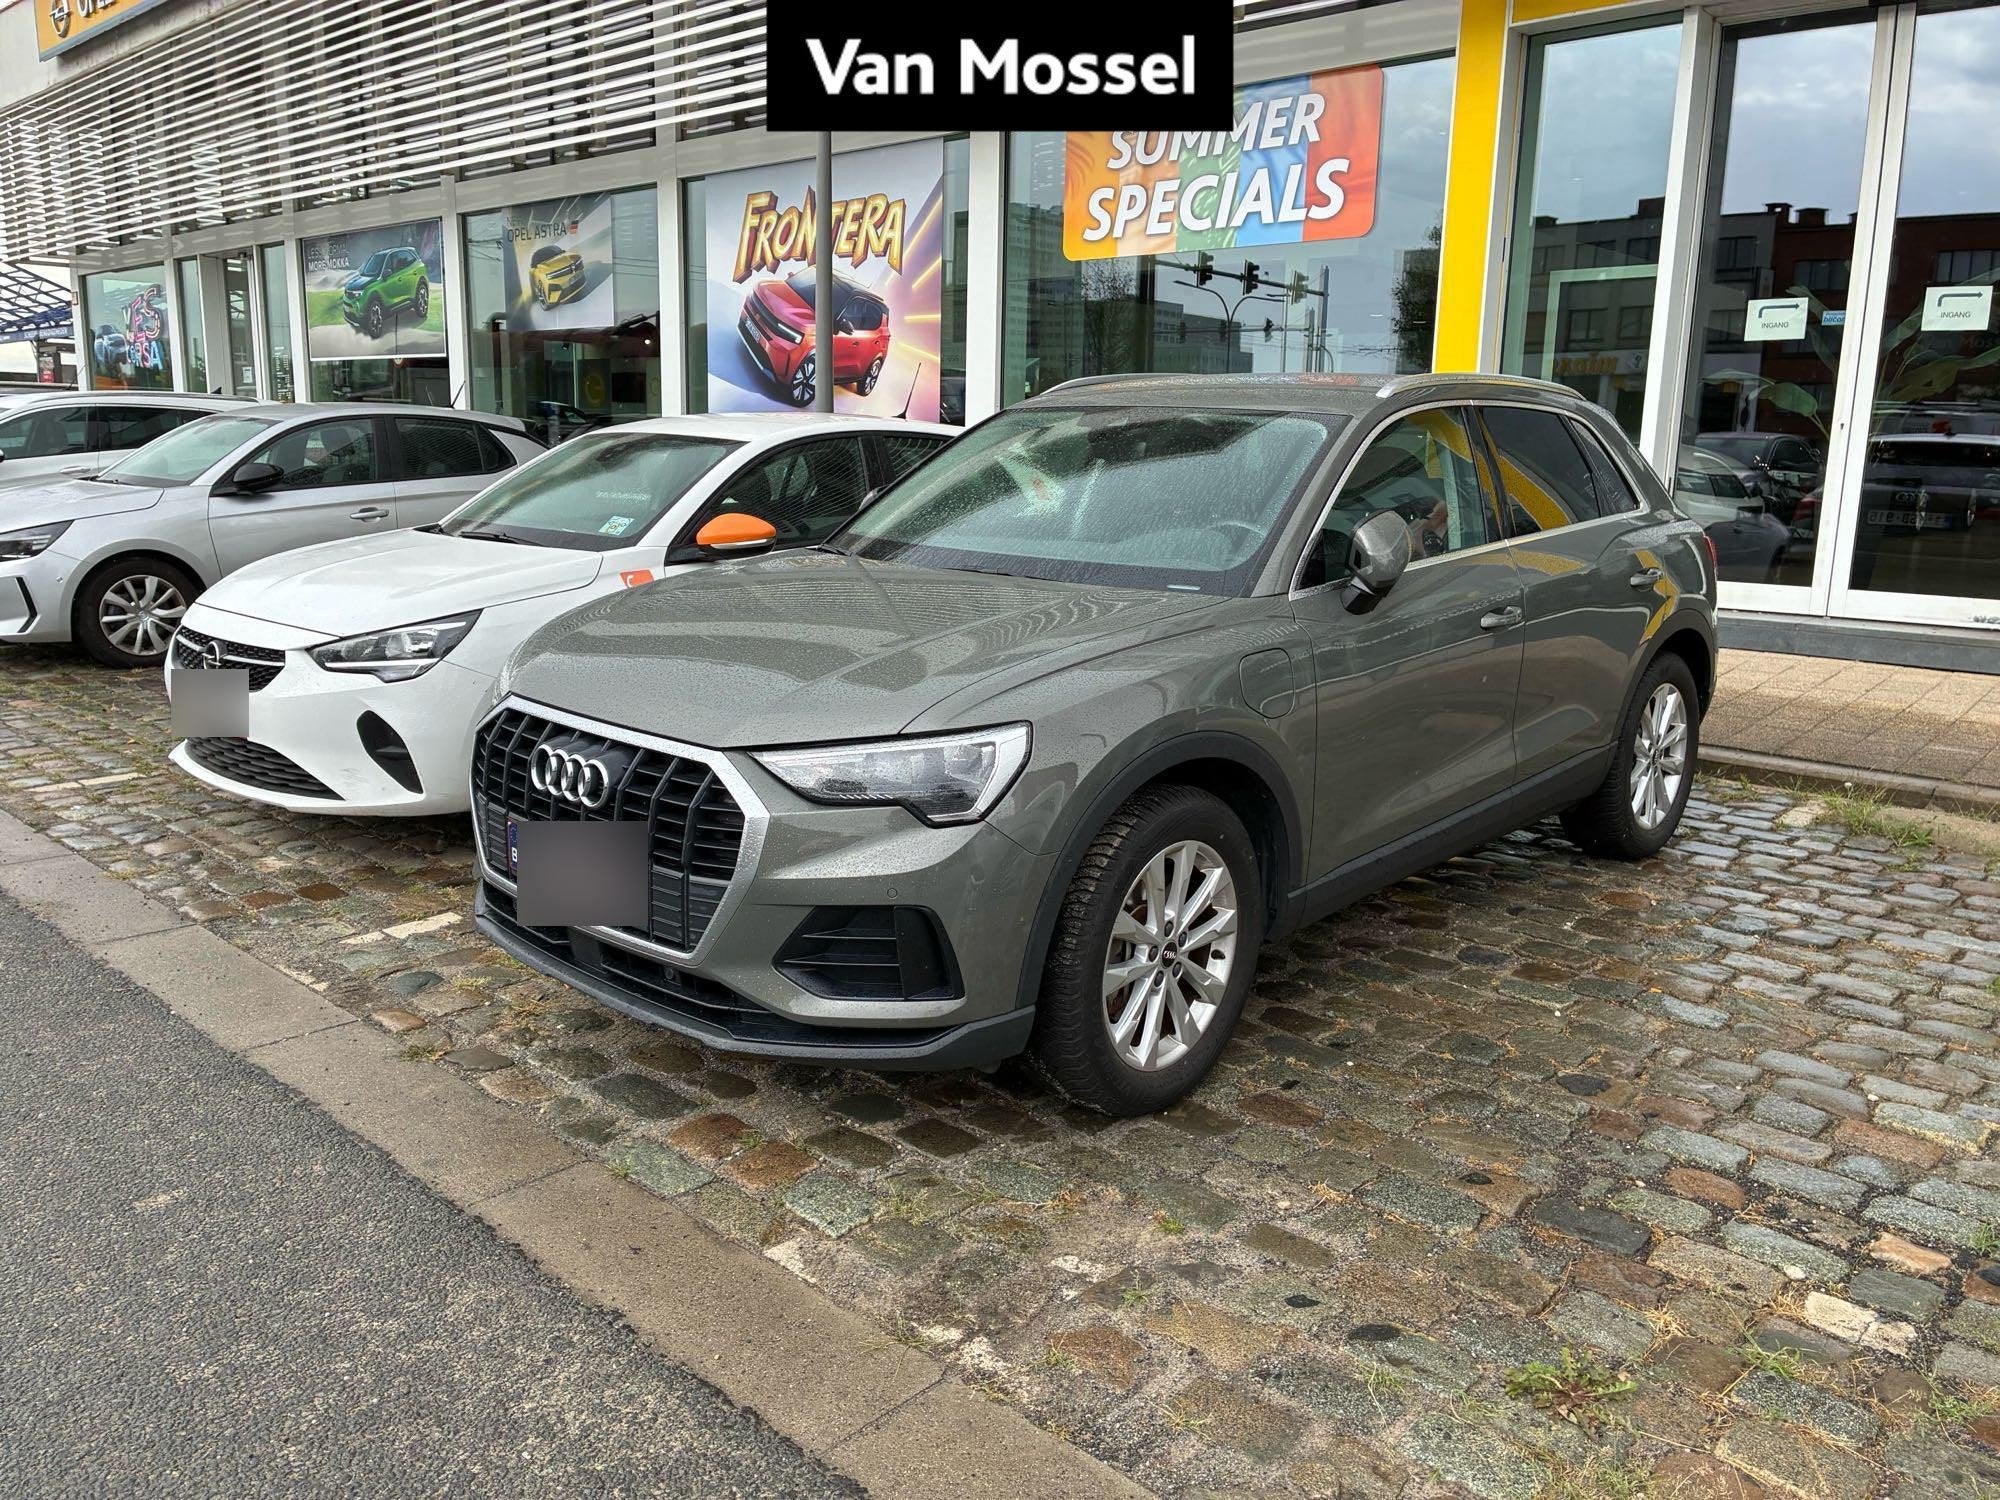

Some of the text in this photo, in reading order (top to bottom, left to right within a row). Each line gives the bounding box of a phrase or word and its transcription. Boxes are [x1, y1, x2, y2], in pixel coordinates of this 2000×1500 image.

[1107, 92, 1325, 169] SUMMER
[1083, 158, 1350, 242] SPECIALS
[507, 222, 567, 242] OPEL ASTRA
[1940, 310, 1972, 319] INGANG
[1761, 321, 1790, 329] INGANG
